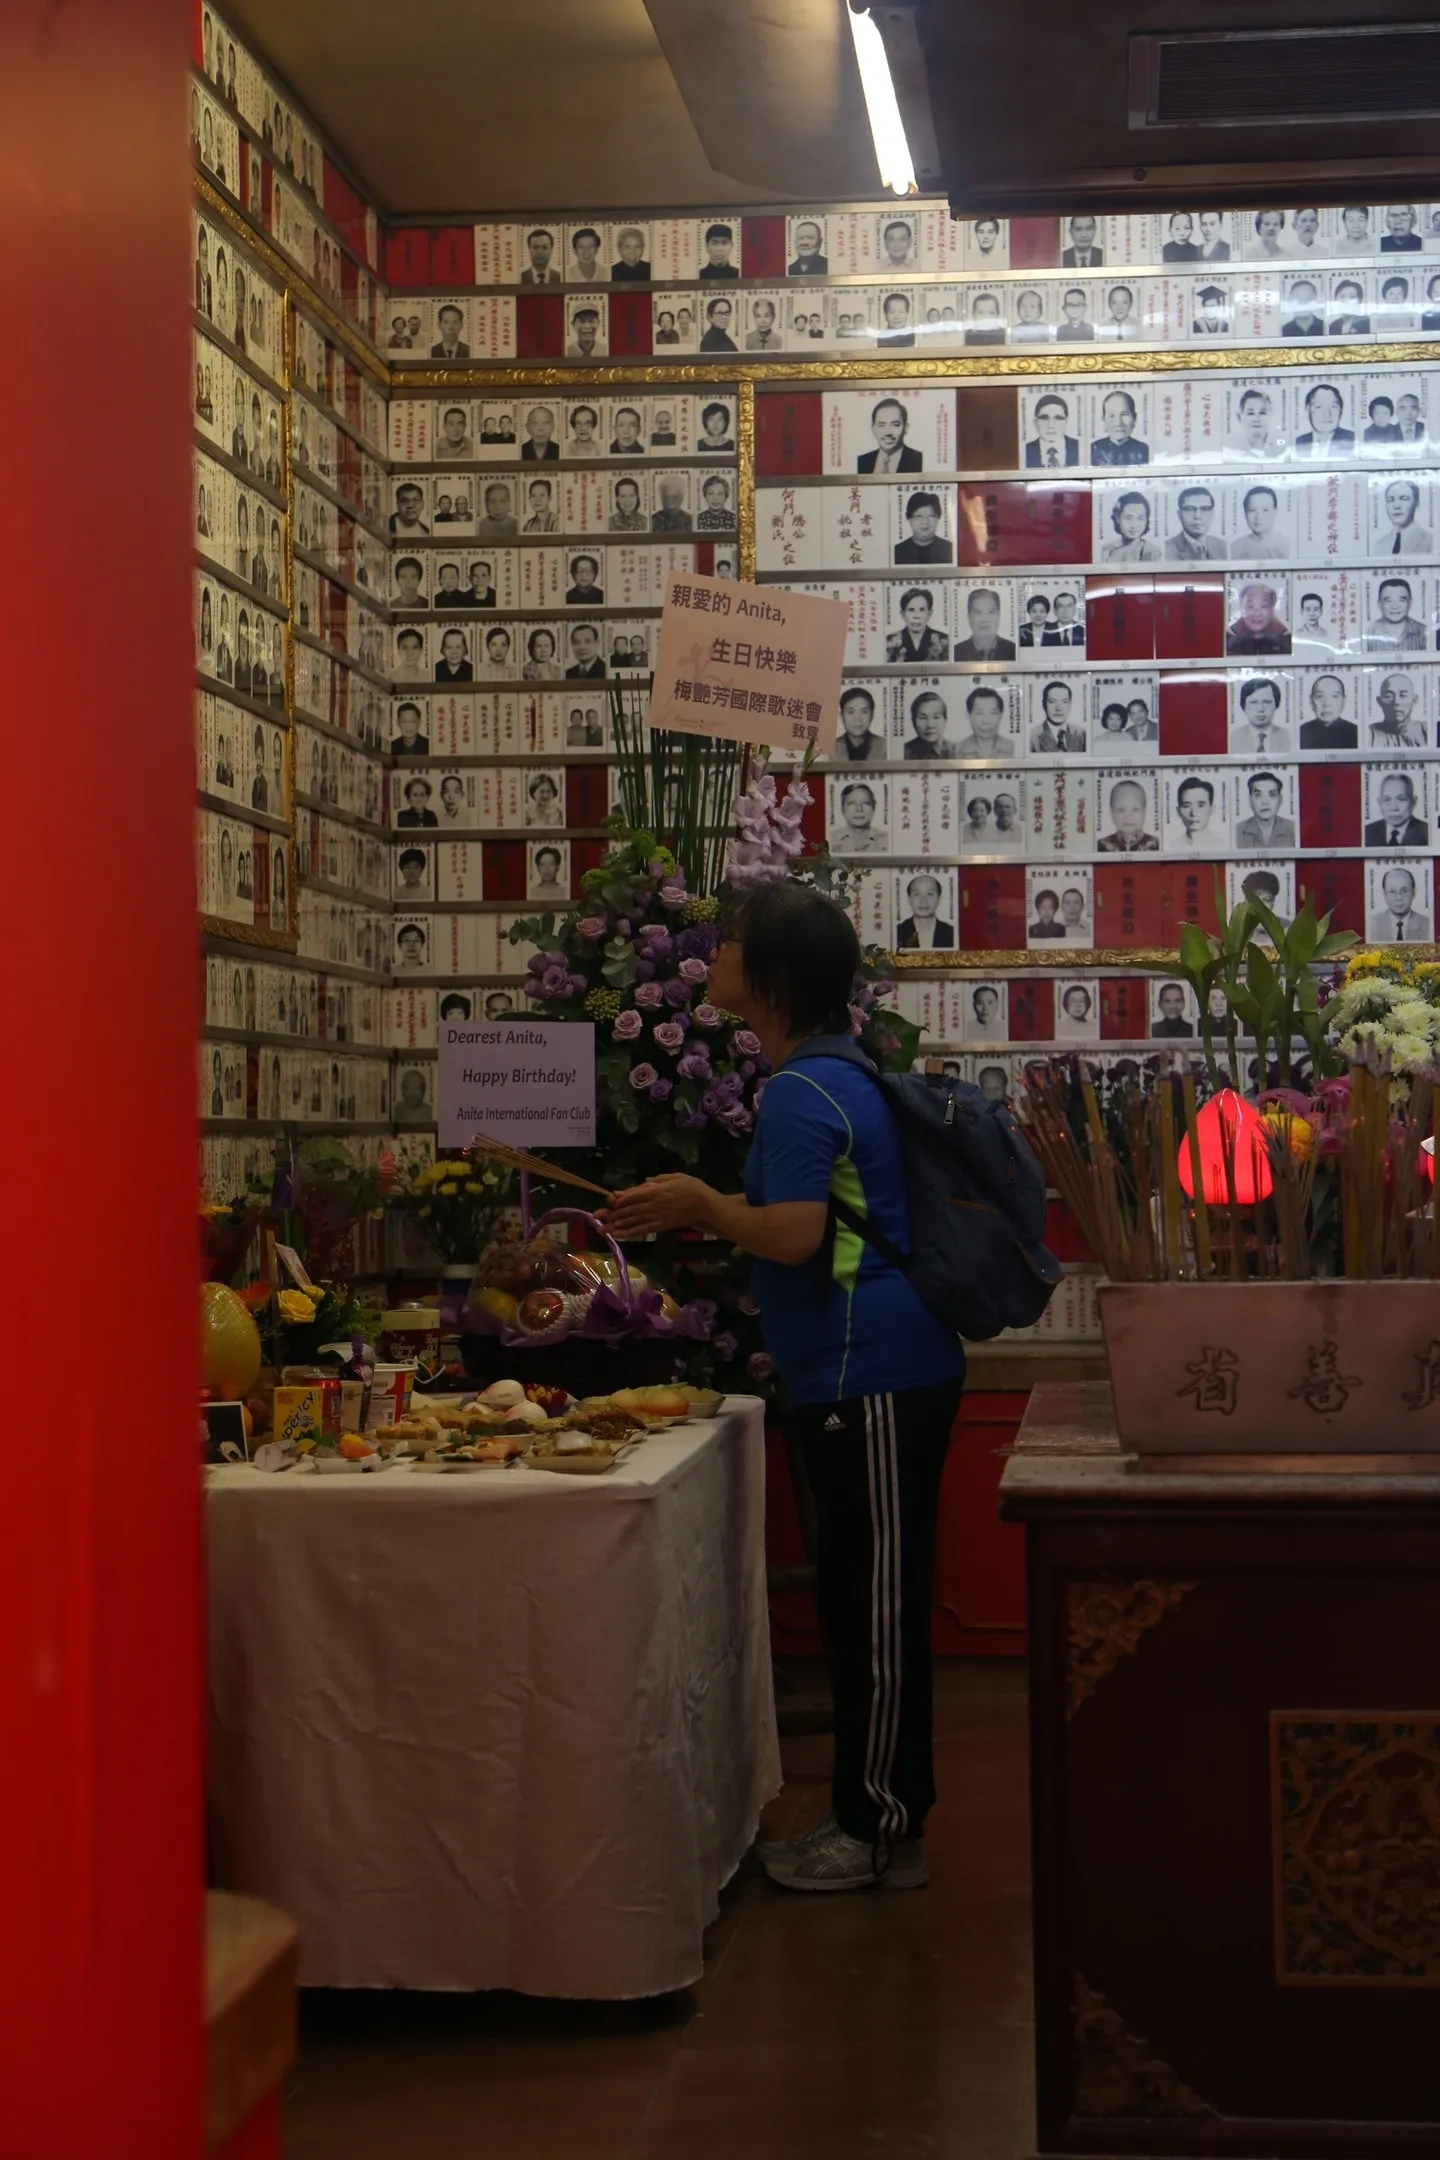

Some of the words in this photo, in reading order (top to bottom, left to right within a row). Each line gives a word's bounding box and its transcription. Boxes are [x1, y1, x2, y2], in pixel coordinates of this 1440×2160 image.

[671, 583, 732, 617] 親愛的
[736, 598, 787, 627] Anita,
[710, 637, 798, 674] 生日快樂
[447, 1030, 502, 1044] Dearest
[505, 1030, 547, 1047] Anita,
[463, 1069, 508, 1087] Happy
[512, 1069, 576, 1087] Birthday!
[457, 1107, 483, 1120] Anita
[485, 1107, 548, 1120] International
[551, 1108, 568, 1120] Fan
[570, 1106, 591, 1120] Club
